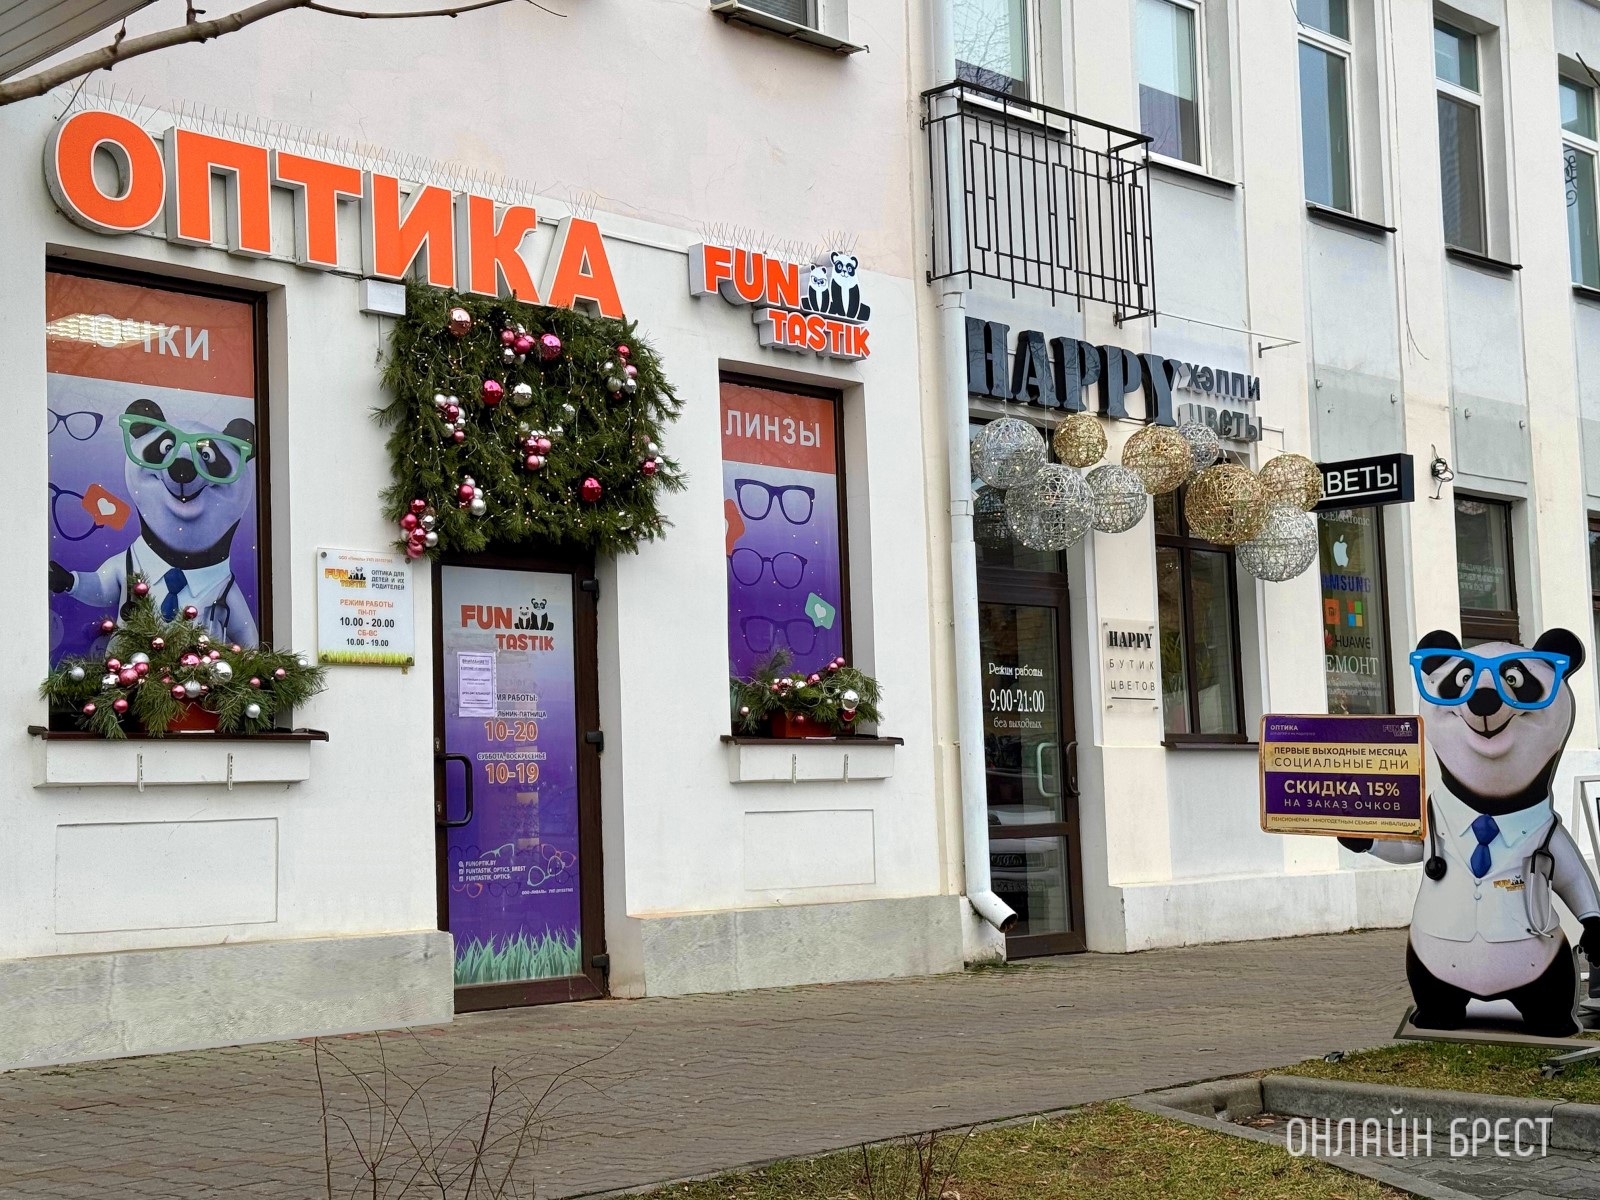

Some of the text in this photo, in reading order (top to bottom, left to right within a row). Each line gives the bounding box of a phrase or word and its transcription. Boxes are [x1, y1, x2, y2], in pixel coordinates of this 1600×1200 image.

[46, 108, 624, 320] ОПТИКА
[700, 243, 800, 310] FUN
[766, 308, 871, 359] TASTIK
[965, 316, 1183, 427] HAPPY
[725, 409, 821, 448] ЛИНЗЫ
[324, 568, 349, 580] FUN
[371, 569, 392, 577] ОПТИКА
[371, 583, 405, 591] РОДИТЕЛЕЙ
[340, 599, 394, 608] РЕЖИМ РАБОТЫ
[340, 617, 364, 626] 10.00
[371, 618, 395, 628] 20.00
[460, 604, 513, 630] FUN
[357, 629, 378, 637] СБ-ВС
[346, 638, 365, 646] 10.00
[371, 639, 389, 647] 19.00
[495, 633, 555, 651] TASTIK
[1108, 631, 1153, 649] HAPPY
[1335, 635, 1374, 650] HUAWEI
[988, 662, 1043, 679] Режим работы
[1109, 658, 1154, 671] БУТИК
[1110, 680, 1156, 692] ЦВЕТОВ
[507, 694, 538, 702] РАБОТЫ:
[989, 688, 1045, 713] 9:00-21:00
[993, 717, 1042, 729] без выходных
[1382, 724, 1400, 733] FUN
[484, 720, 538, 741] 10-20
[506, 752, 546, 760] ВОСКРЕСЕНЬЕ
[1274, 747, 1408, 757] ПЕРВЫЕ ВЫХОДНЫЕ МЕСЯЦА
[1274, 757, 1409, 771] СОЦИАЛЬНЫЕ ДНИ
[485, 762, 539, 784] 10-19
[1284, 780, 1400, 797] СКИДКА 15%
[1284, 798, 1401, 811] НА ЗАКАЗ ОЧКОВ
